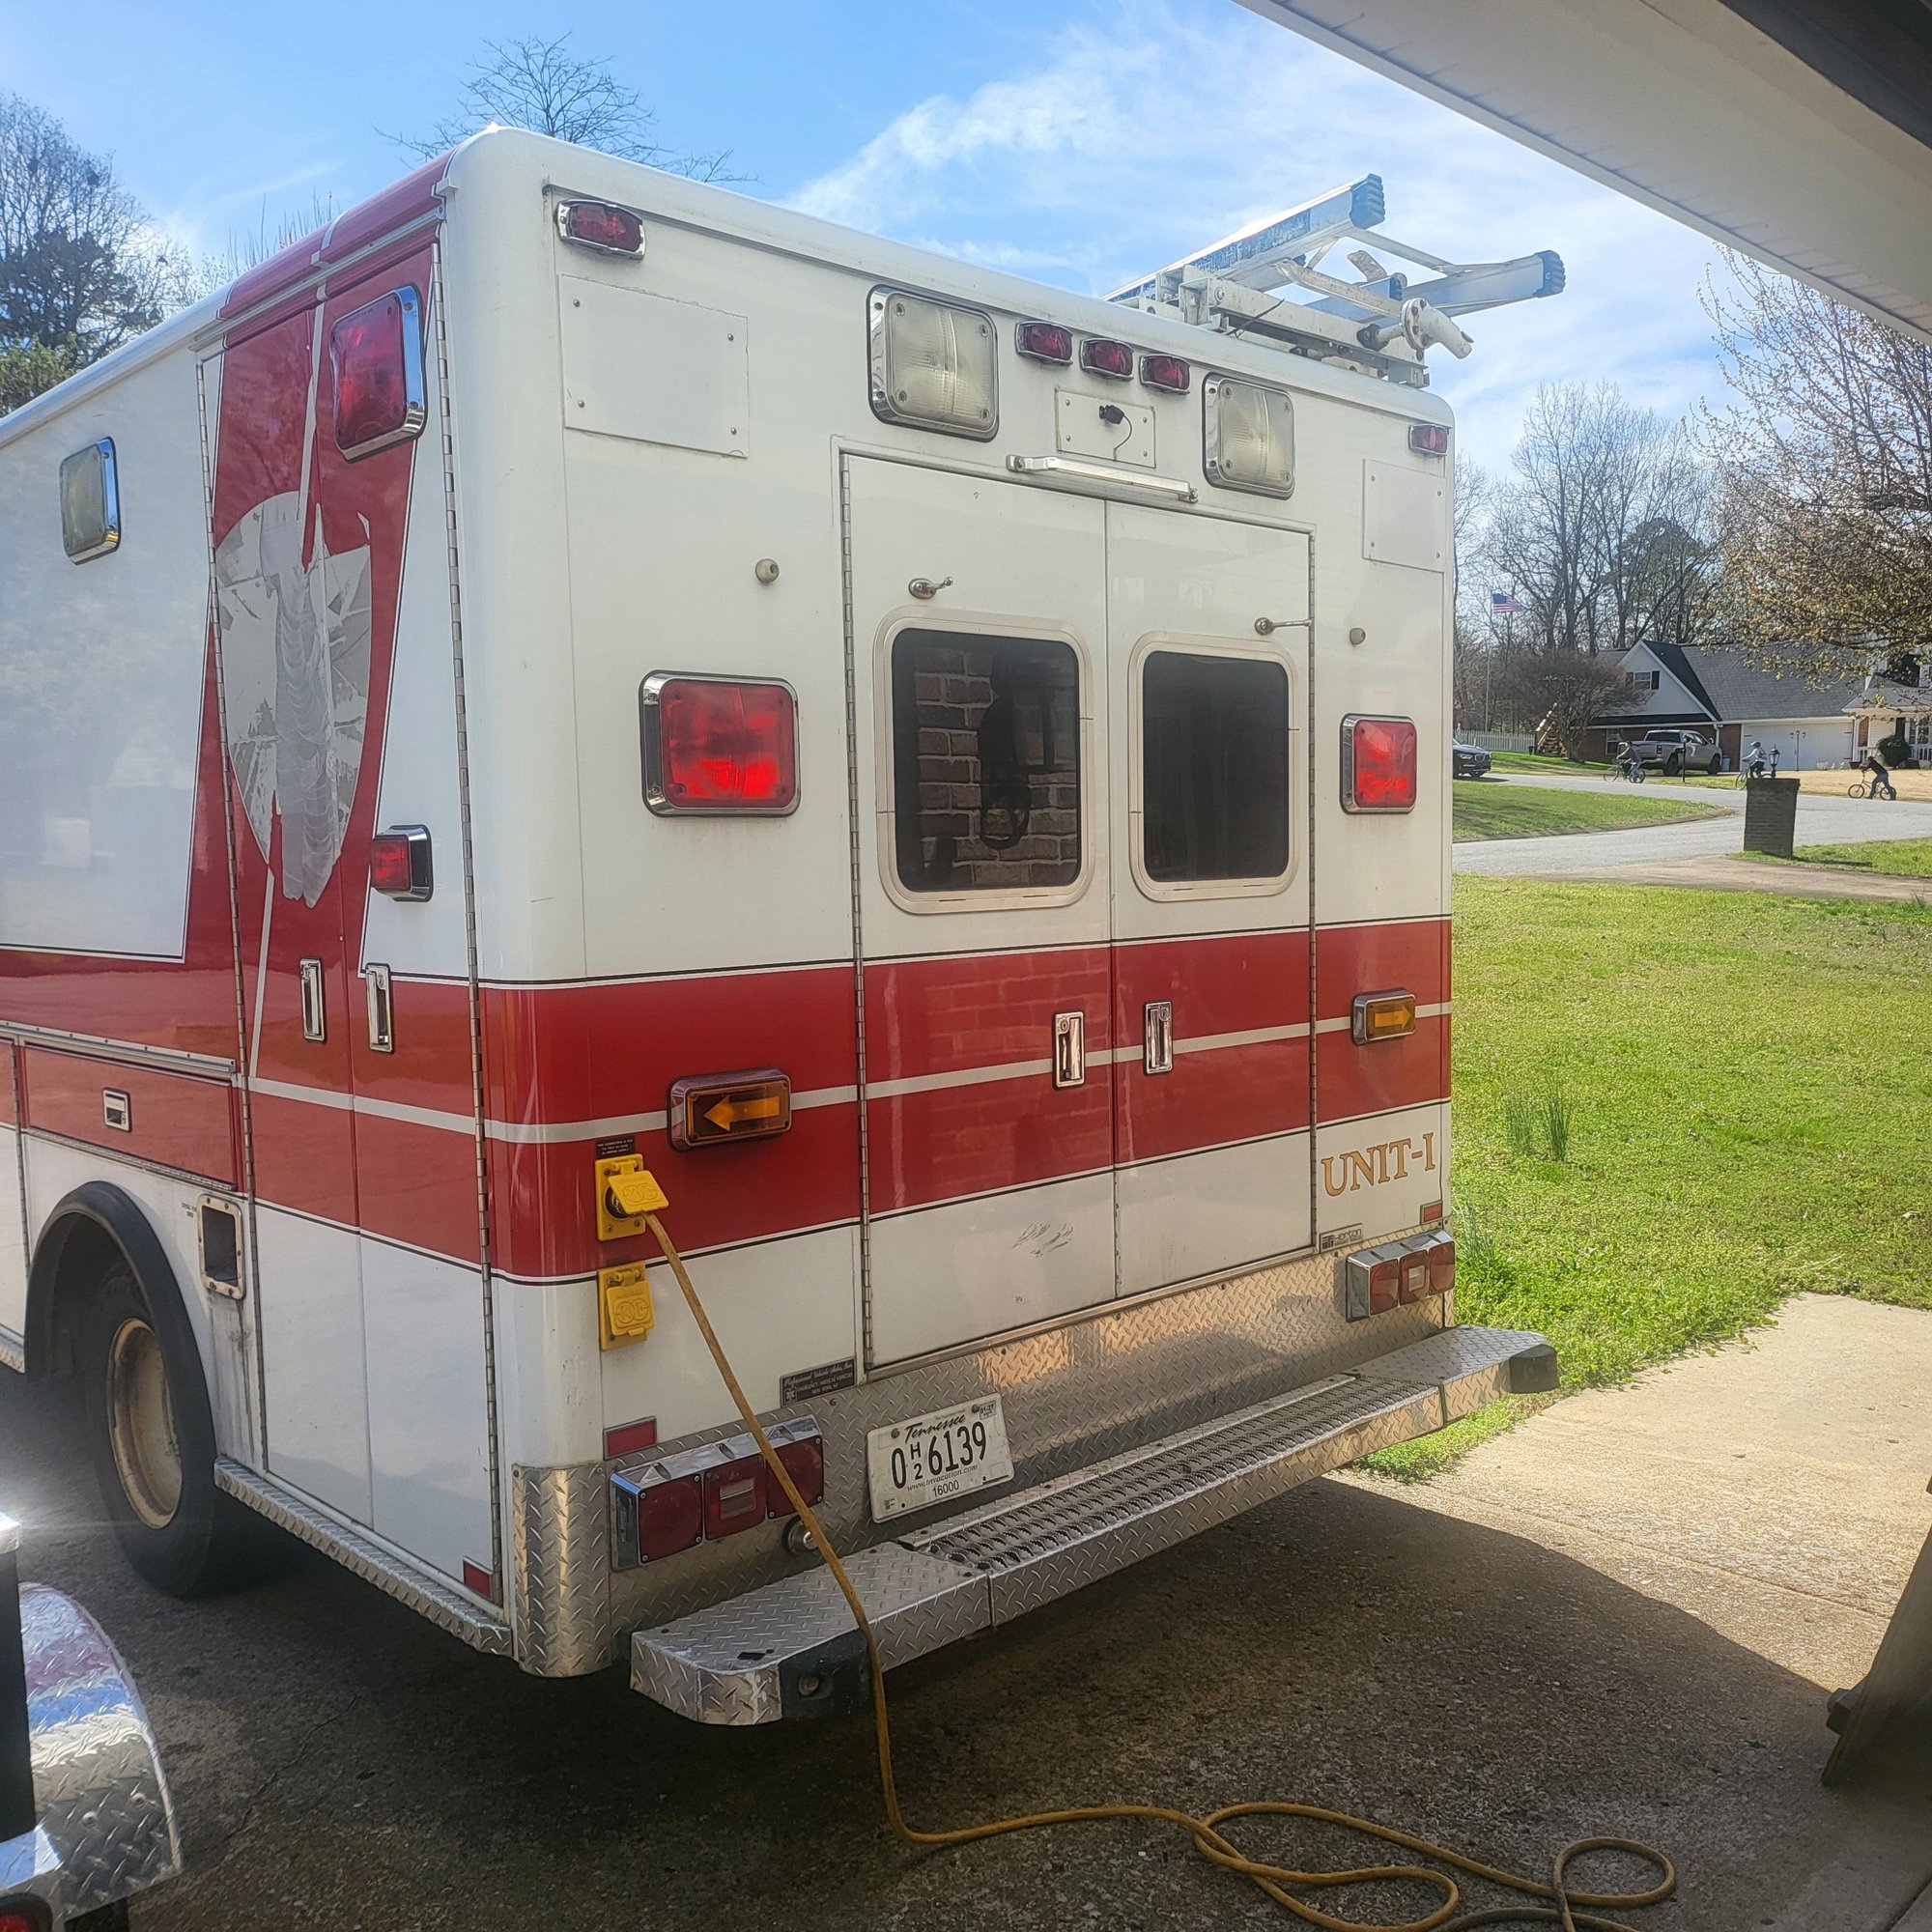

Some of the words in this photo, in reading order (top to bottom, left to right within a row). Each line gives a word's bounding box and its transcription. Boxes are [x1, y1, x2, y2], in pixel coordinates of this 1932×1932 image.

[904, 1414, 965, 1444] Tennessee
[906, 1464, 979, 1492] www.tnvacation.com
[932, 1480, 959, 1497] 16000
